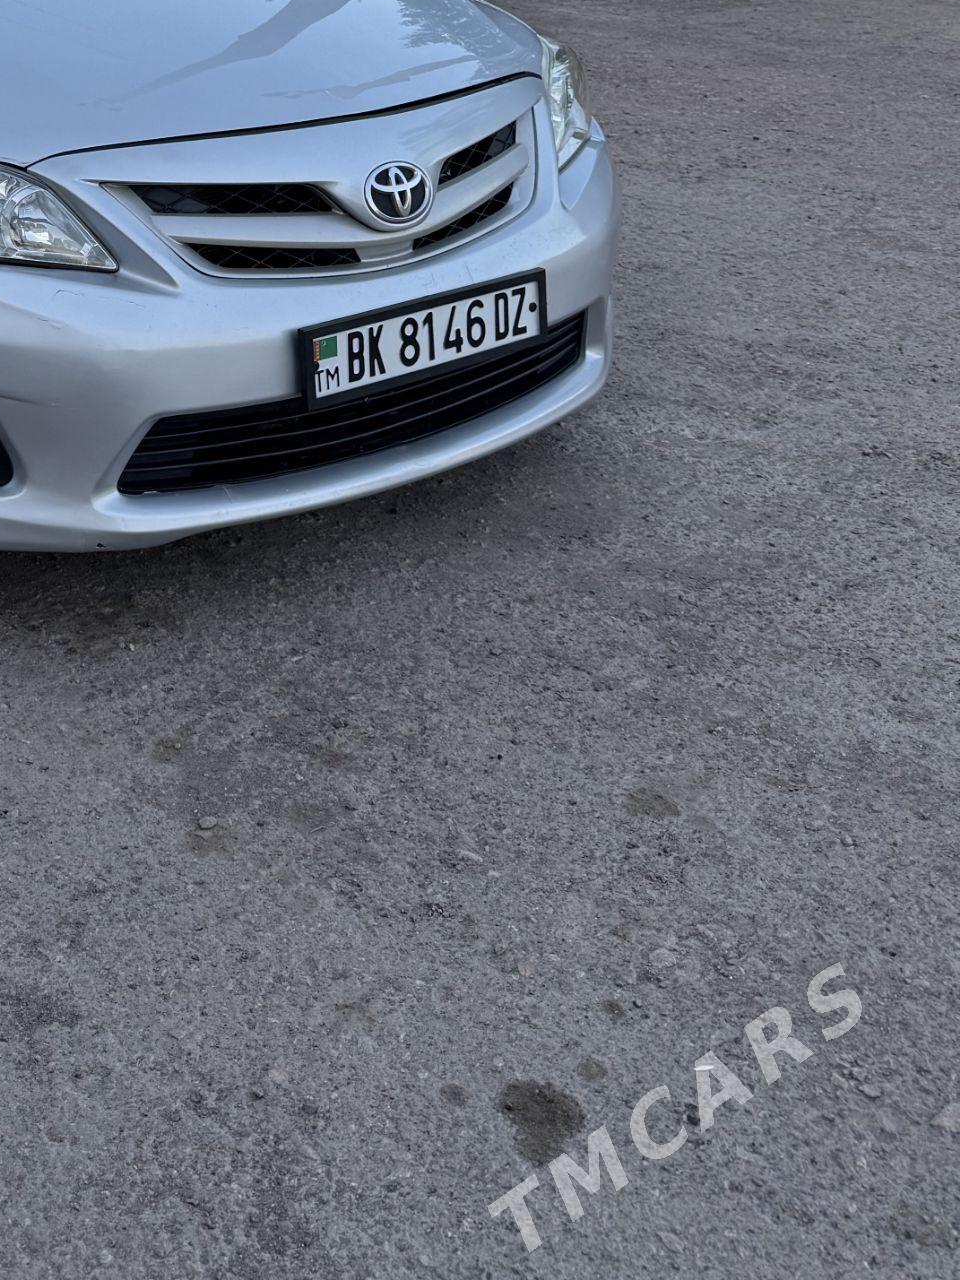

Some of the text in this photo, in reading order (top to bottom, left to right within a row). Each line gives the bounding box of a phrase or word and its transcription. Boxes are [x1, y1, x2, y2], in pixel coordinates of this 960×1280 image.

[348, 287, 527, 383] BK 8146 DZ
[314, 366, 340, 393] TM
